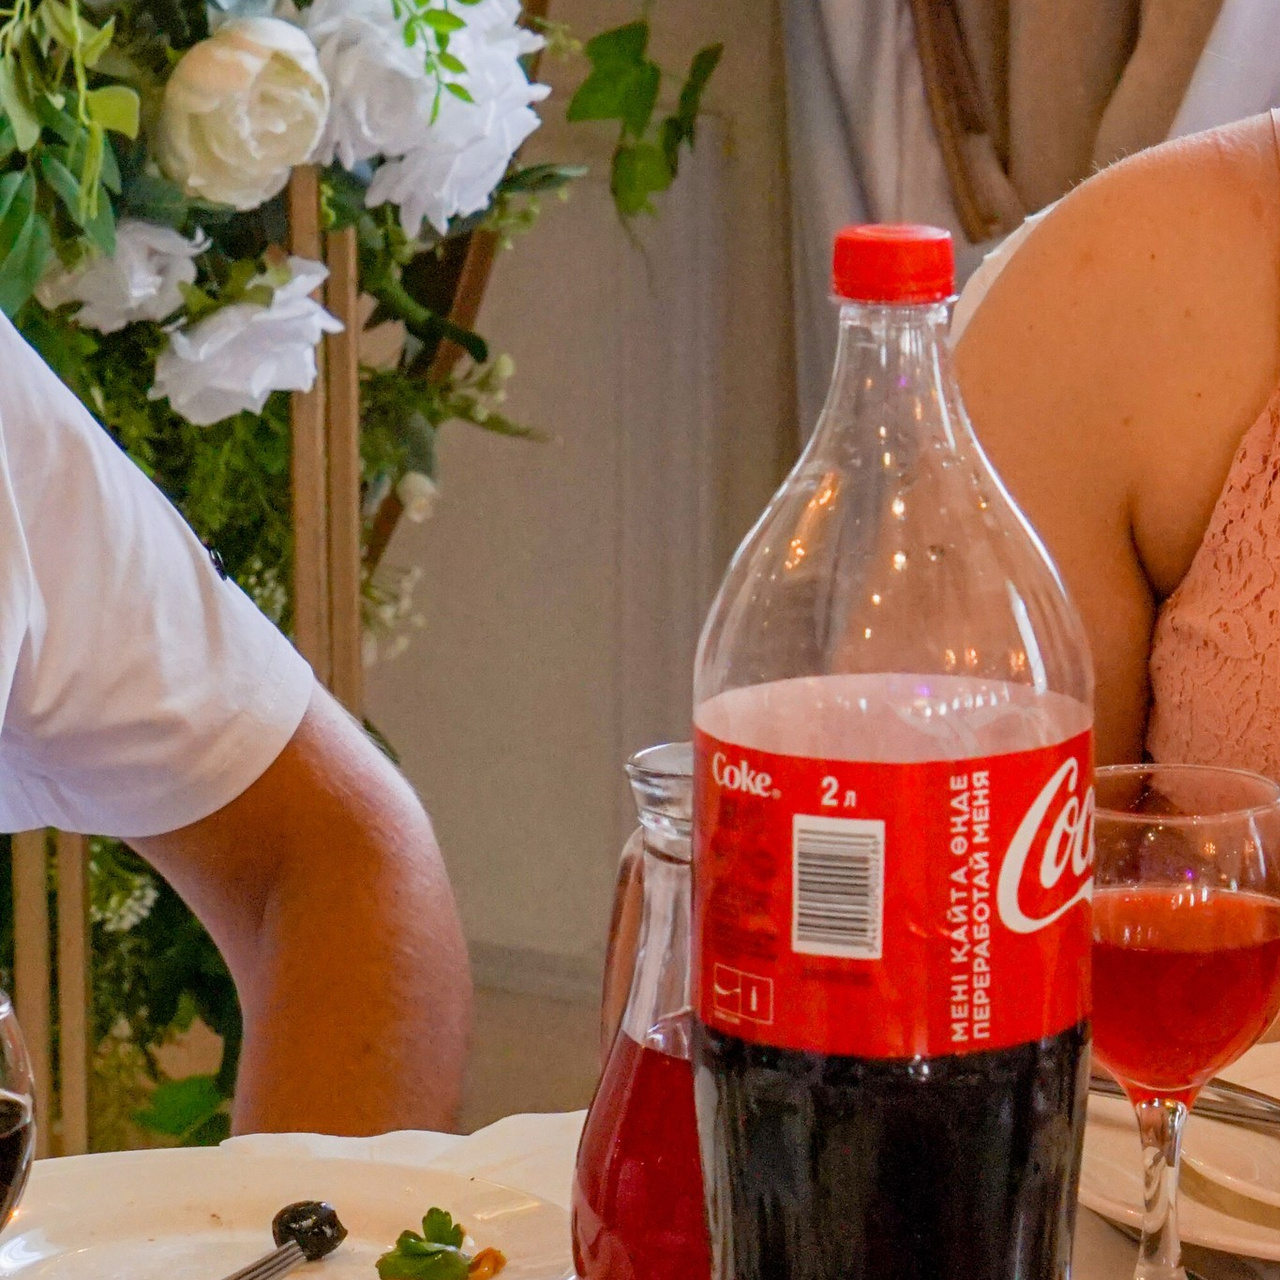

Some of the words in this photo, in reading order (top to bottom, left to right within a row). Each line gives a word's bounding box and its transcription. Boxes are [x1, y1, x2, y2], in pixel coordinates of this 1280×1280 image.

[821, 776, 839, 806] 2
[972, 770, 990, 843] МЕНЯ
[968, 851, 991, 1039] ПЕРЕРАБОТАЙ
